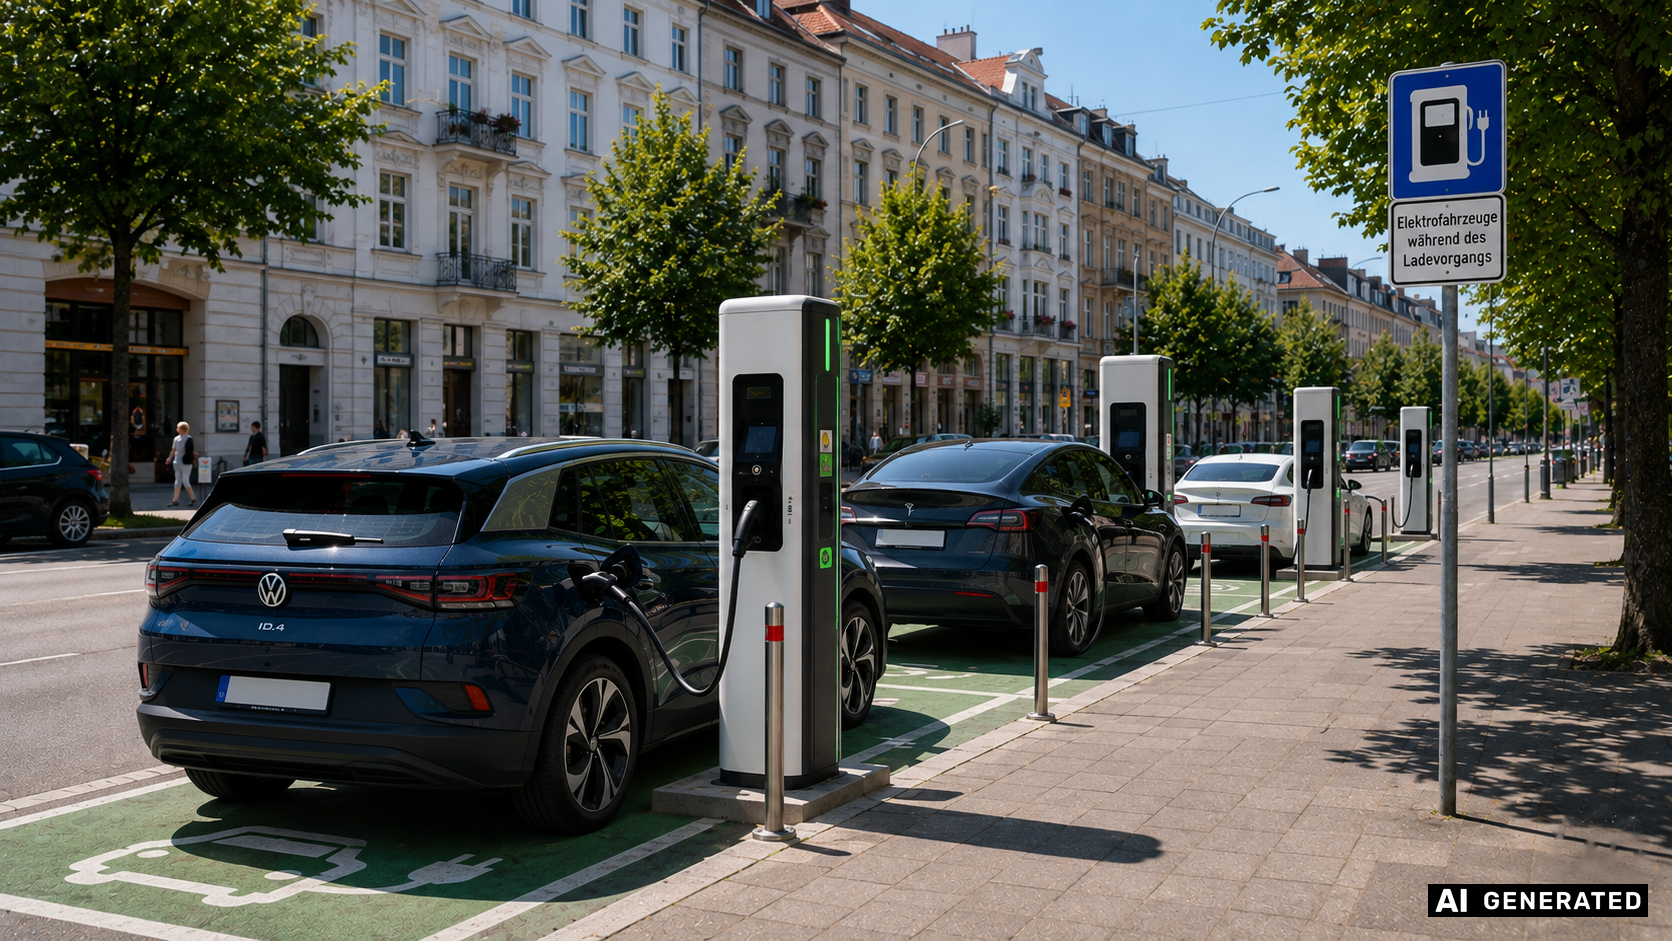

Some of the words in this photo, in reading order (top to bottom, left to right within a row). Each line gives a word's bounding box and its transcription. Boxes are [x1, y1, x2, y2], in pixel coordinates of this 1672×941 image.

[1397, 212, 1498, 229] Elektrofahrzeuge
[1407, 232, 1460, 247] während
[1464, 231, 1486, 244] des
[1403, 252, 1492, 267] Ladevorgangs
[258, 573, 287, 607] VW
[258, 622, 285, 631] ID.4
